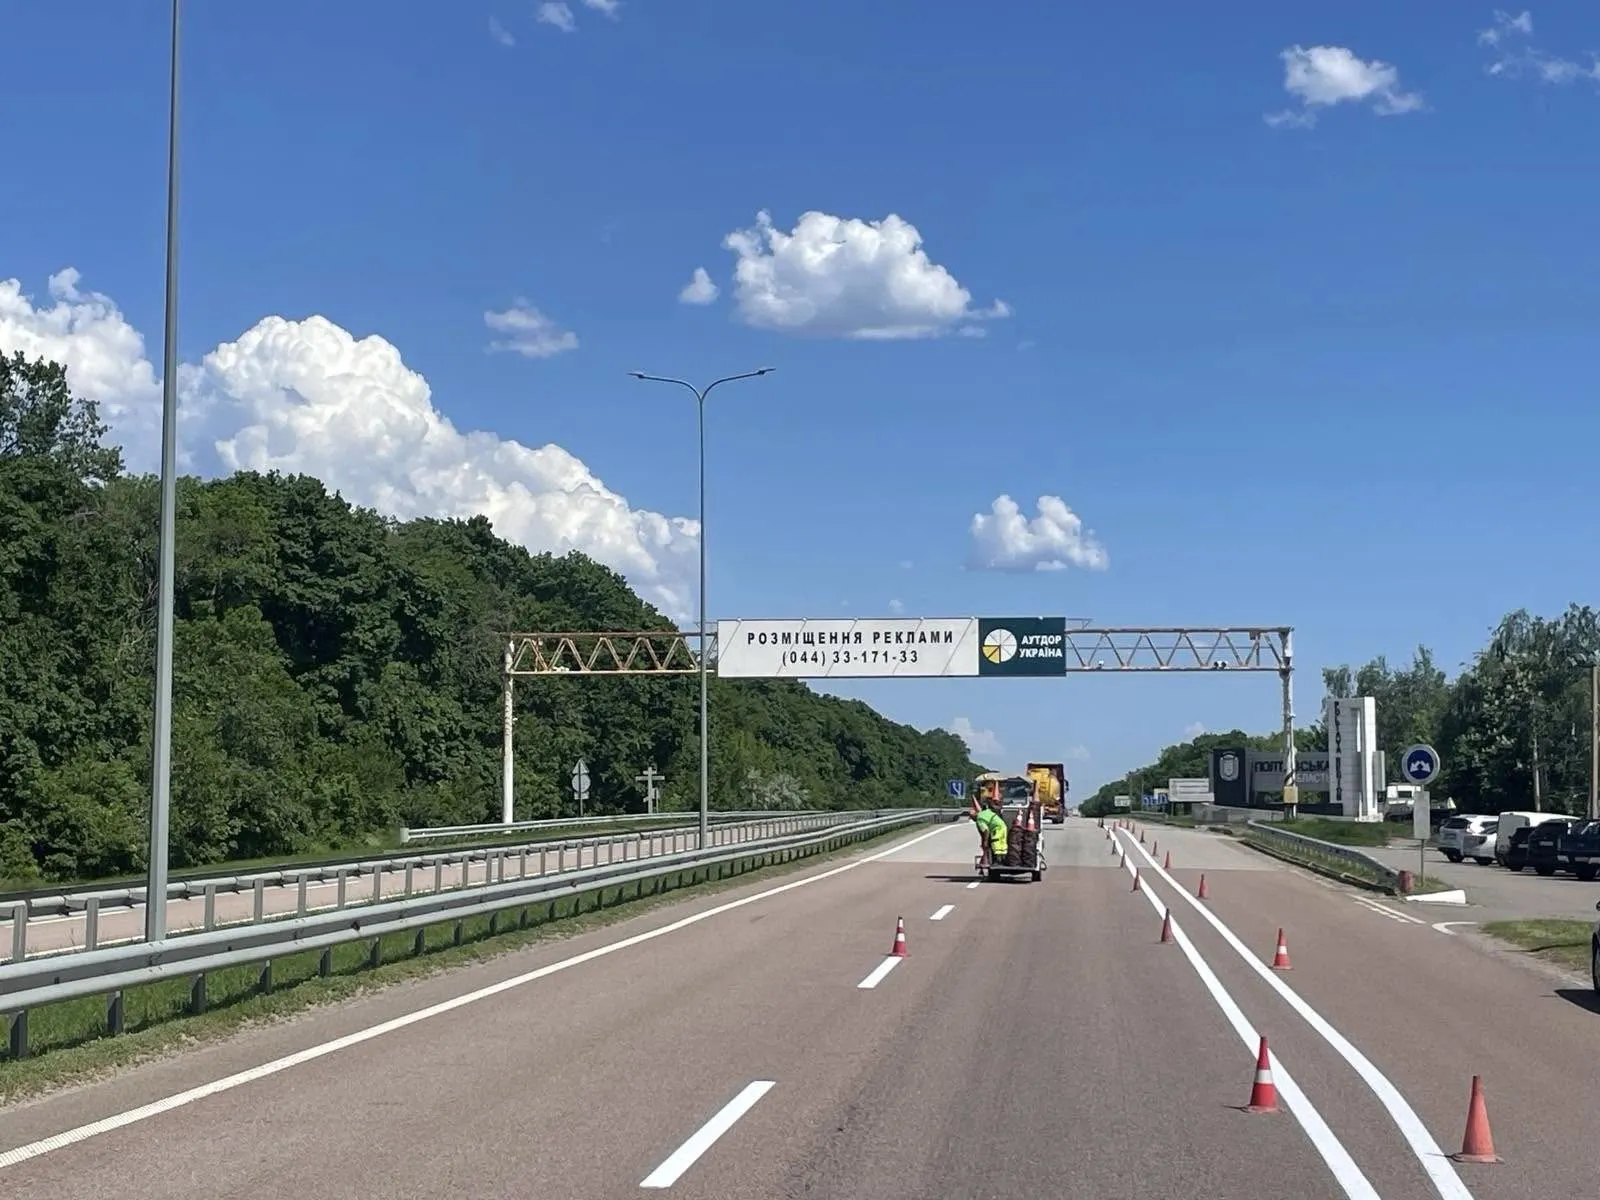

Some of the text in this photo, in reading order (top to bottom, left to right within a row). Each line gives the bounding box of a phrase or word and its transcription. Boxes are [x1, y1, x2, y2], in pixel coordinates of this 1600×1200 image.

[747, 630, 954, 647] РОЗМІЩЕННЯ РЕКЛАМИ
[1021, 634, 1062, 647] АУТДОР
[782, 650, 919, 666] (044) 33-171-33
[1019, 647, 1063, 658] УКРАЇНА
